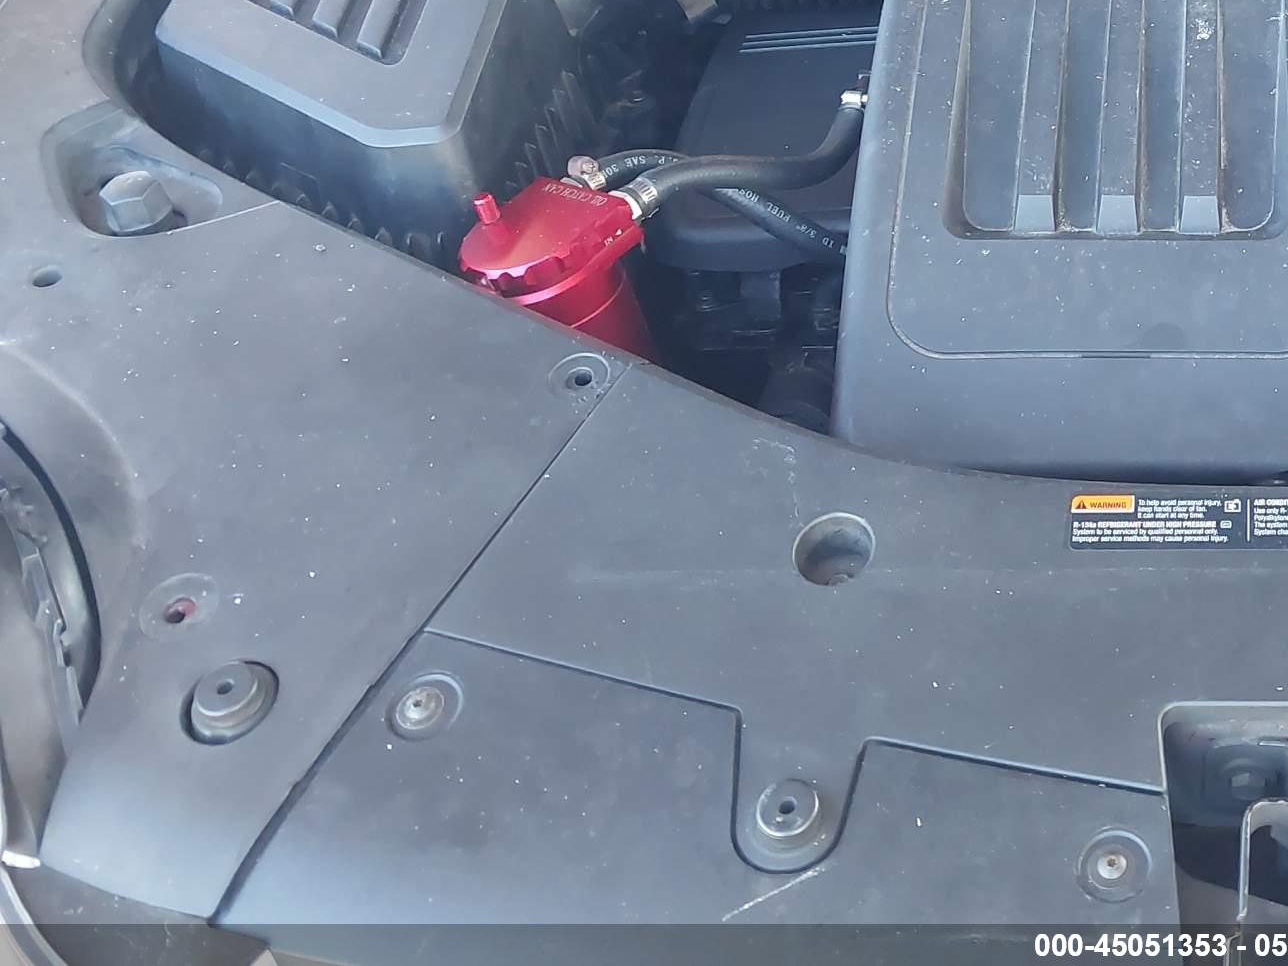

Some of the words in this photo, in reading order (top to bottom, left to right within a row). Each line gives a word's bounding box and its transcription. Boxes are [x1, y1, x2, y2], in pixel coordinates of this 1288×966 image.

[623, 154, 647, 168] SAE
[542, 183, 562, 194] CAN
[560, 190, 591, 202] CATCH
[590, 196, 608, 207] OIL
[603, 236, 615, 247] IN
[1089, 501, 1127, 509] WARNING
[1146, 499, 1160, 507] help
[1160, 499, 1177, 507] avoid
